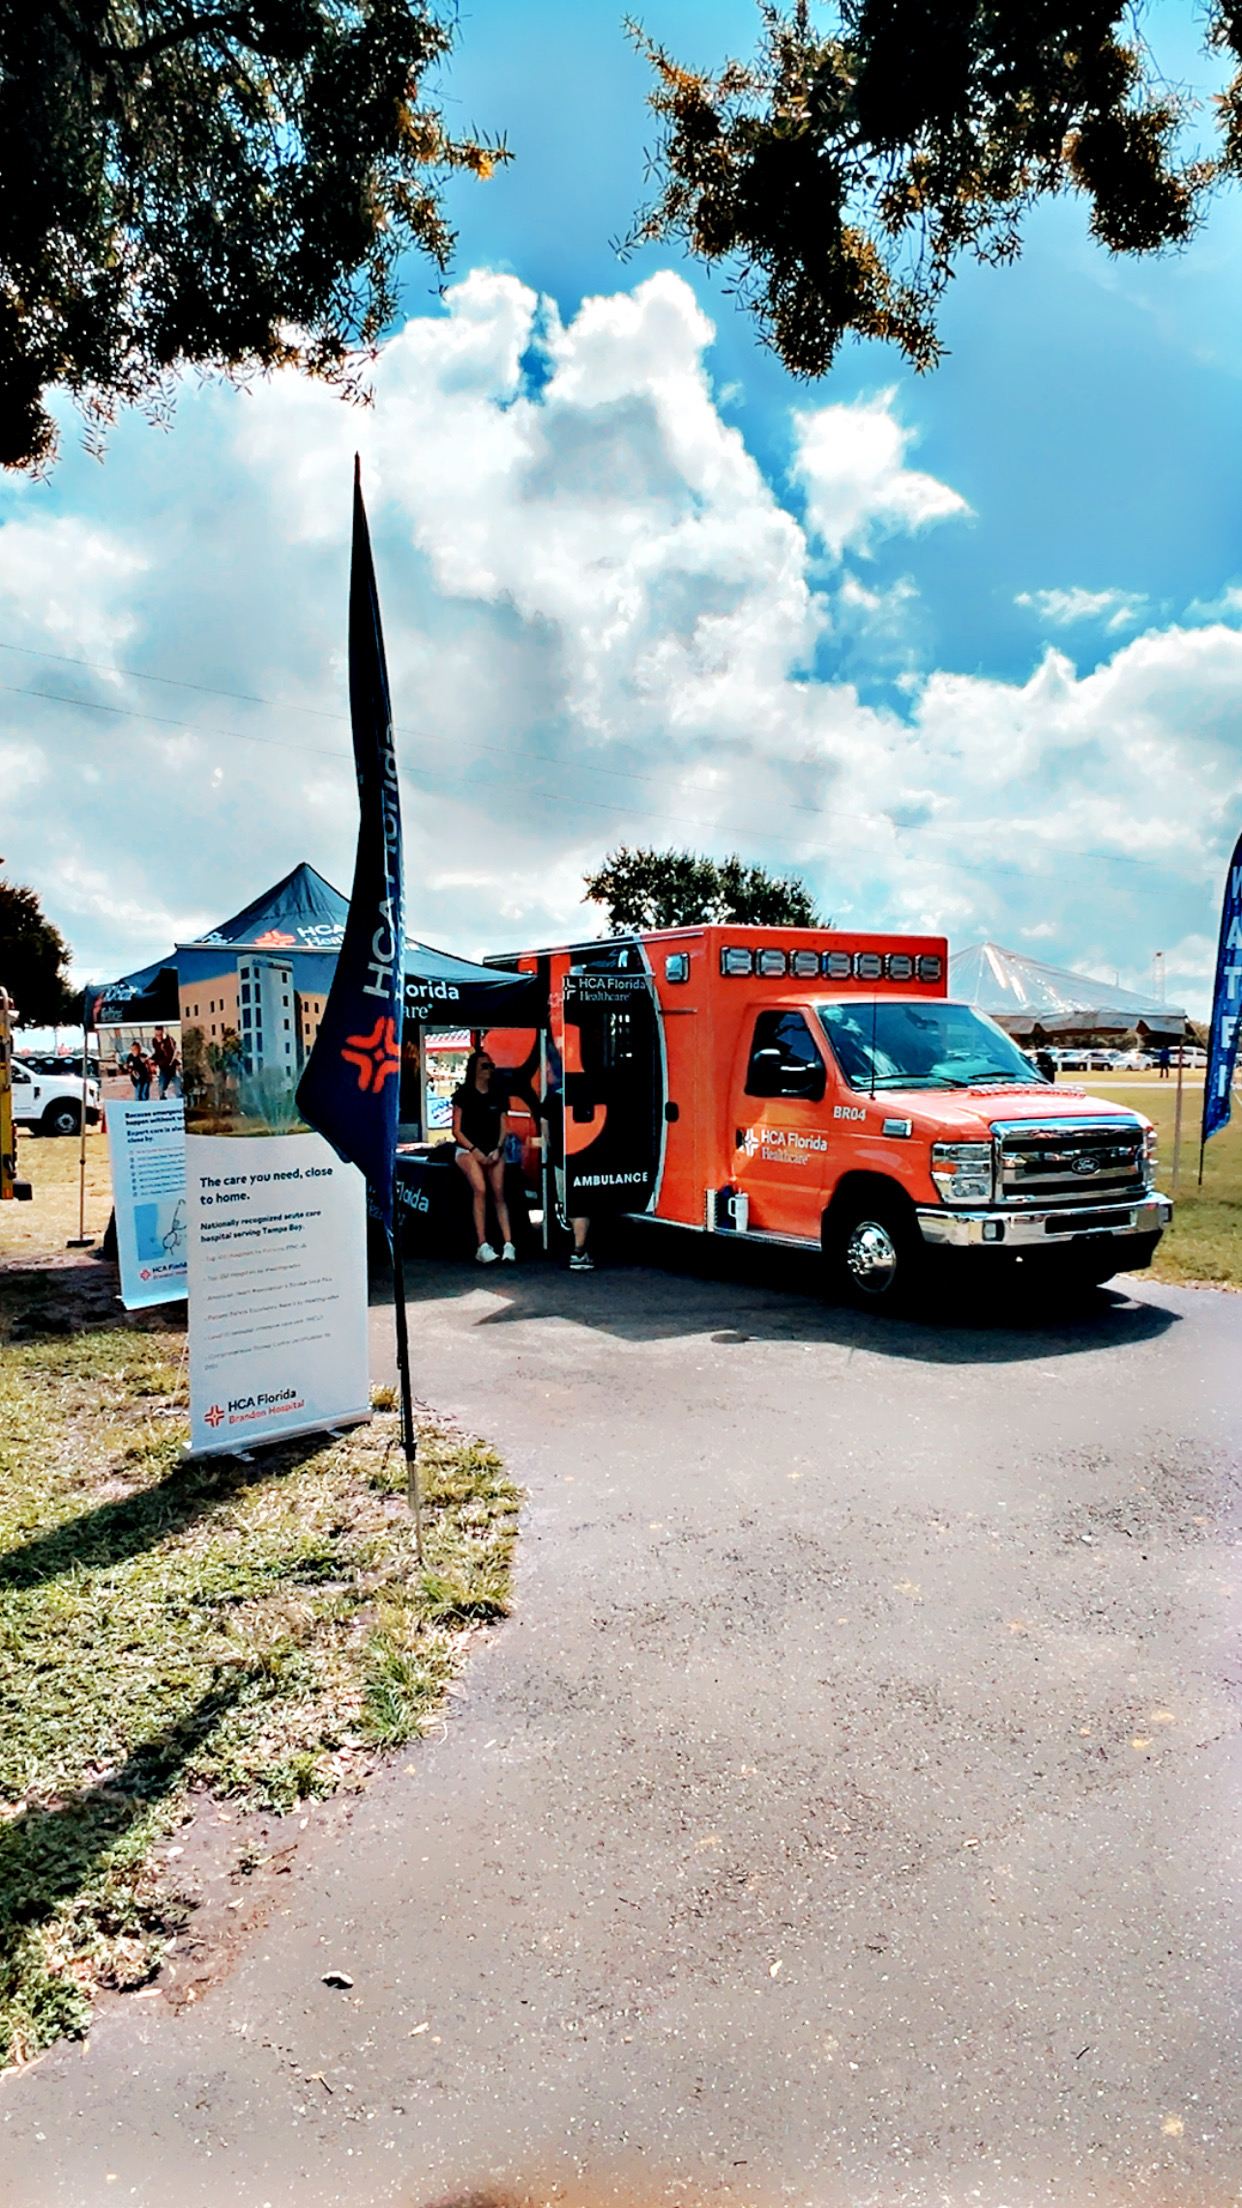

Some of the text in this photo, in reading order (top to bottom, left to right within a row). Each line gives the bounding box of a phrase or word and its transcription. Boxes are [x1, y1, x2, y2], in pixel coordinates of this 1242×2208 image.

[297, 924, 346, 938] HCA
[405, 980, 460, 1000] orida
[579, 978, 646, 990] HCA Florida
[833, 1105, 867, 1121] BR04
[761, 1129, 828, 1151] HCA Florida
[200, 1167, 333, 1188] The care you need, close
[573, 1171, 648, 1188] AMBULANCE
[200, 1192, 250, 1205] to home.
[200, 1218, 239, 1231] Nationally
[241, 1213, 282, 1225] recognized
[305, 1209, 322, 1217] care
[200, 1231, 232, 1243] hospital
[233, 1229, 261, 1239] serving
[262, 1225, 288, 1236] Tampa
[152, 1264, 168, 1274] HCA
[228, 1388, 297, 1412] HCA Florida
[229, 1399, 305, 1424] Brandon Hospital
